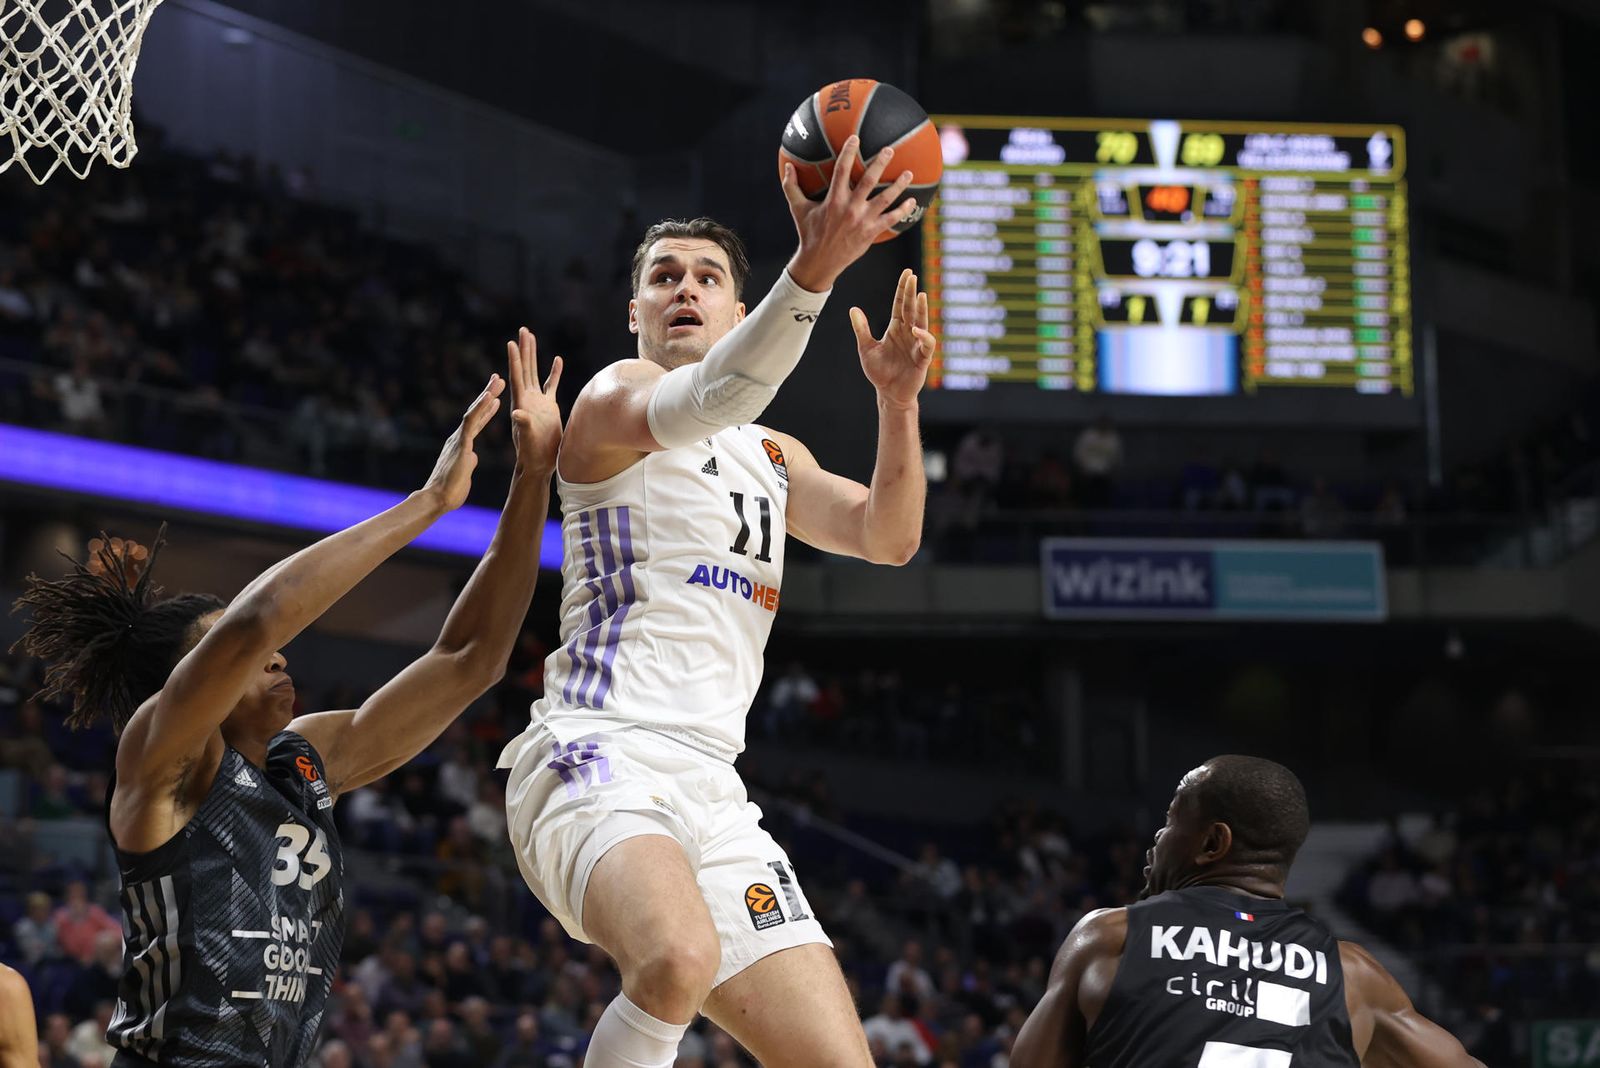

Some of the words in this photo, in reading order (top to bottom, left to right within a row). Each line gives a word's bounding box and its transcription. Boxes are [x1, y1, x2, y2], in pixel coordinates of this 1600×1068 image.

[1131, 239, 1211, 278] 9:21
[730, 491, 771, 563] 11
[686, 564, 780, 613] AUTOHE
[271, 823, 331, 891] 35
[271, 915, 322, 944] SMAT
[1150, 925, 1328, 985] KAHUDI
[1166, 972, 1254, 1006] ciril
[1206, 997, 1254, 1018] GROUP
